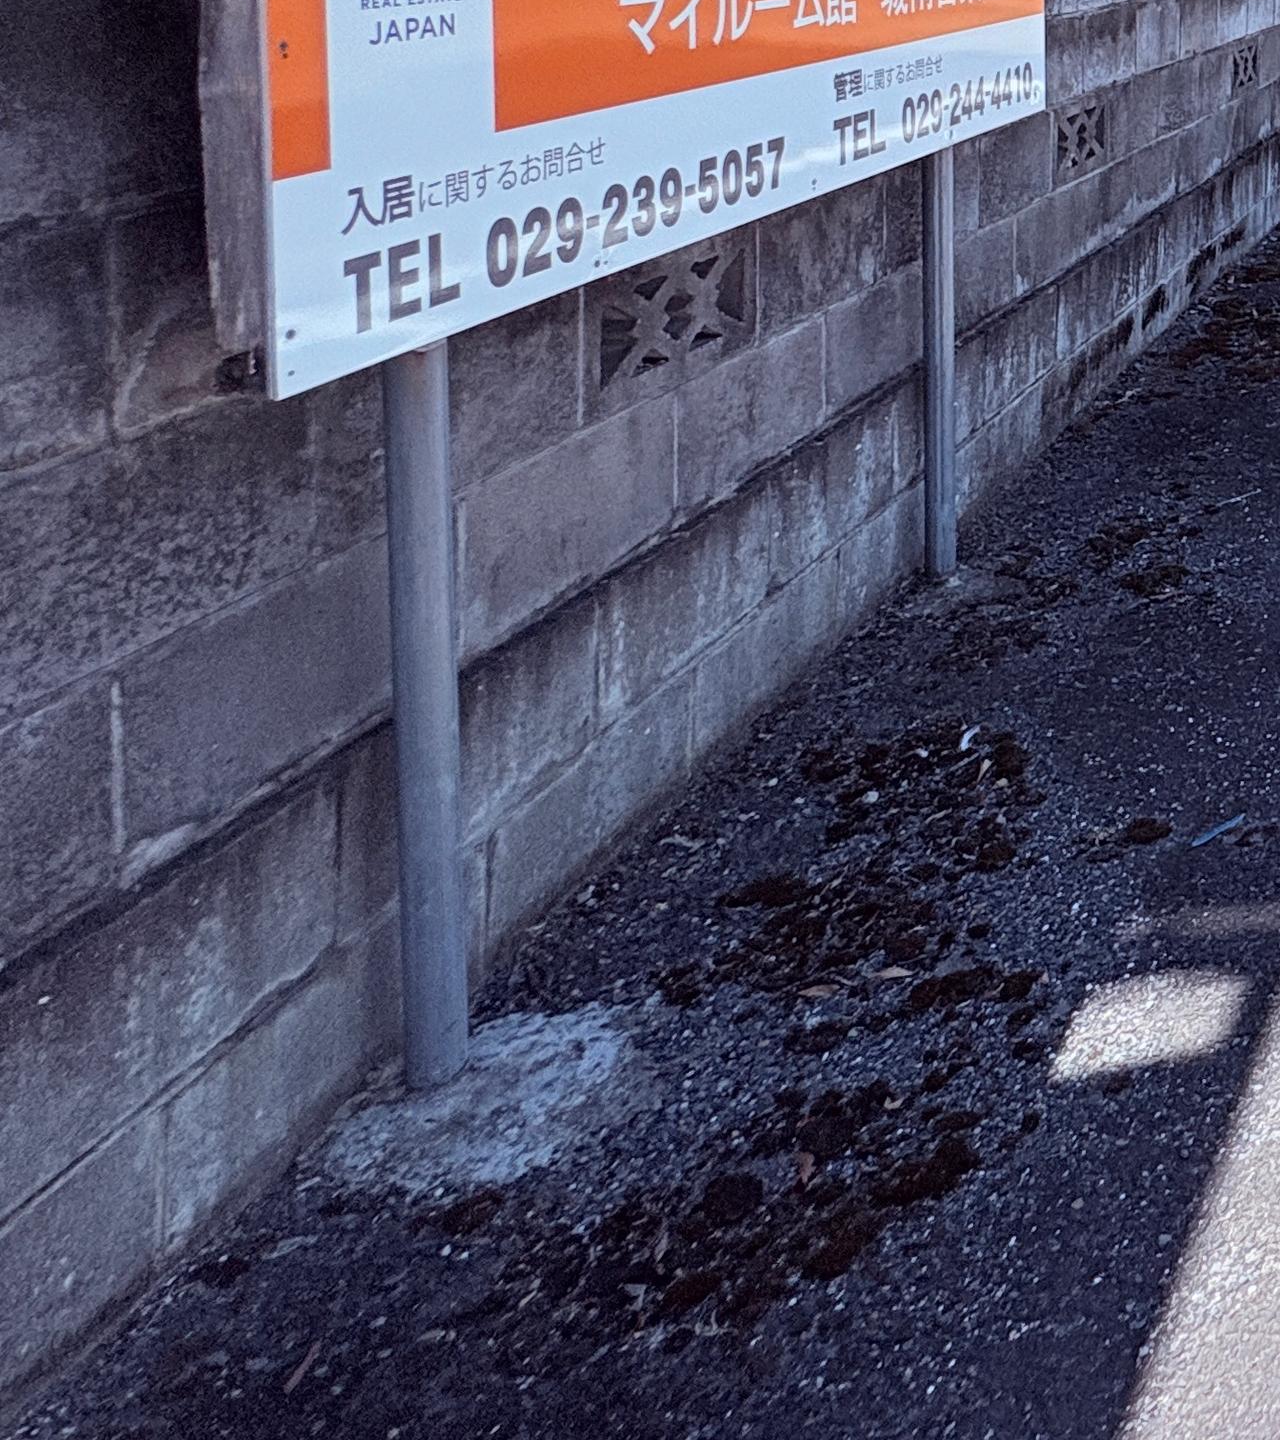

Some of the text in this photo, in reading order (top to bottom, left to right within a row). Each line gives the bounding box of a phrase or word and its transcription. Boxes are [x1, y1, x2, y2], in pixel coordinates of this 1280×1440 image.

[369, 12, 456, 46] JAPAN
[833, 54, 944, 103] 管理に関するお問合せ
[833, 61, 1034, 166] TEL 029-244-4410
[340, 136, 607, 236] 入居に関するお問合せ
[342, 135, 787, 335] TEL 029-239-5057
